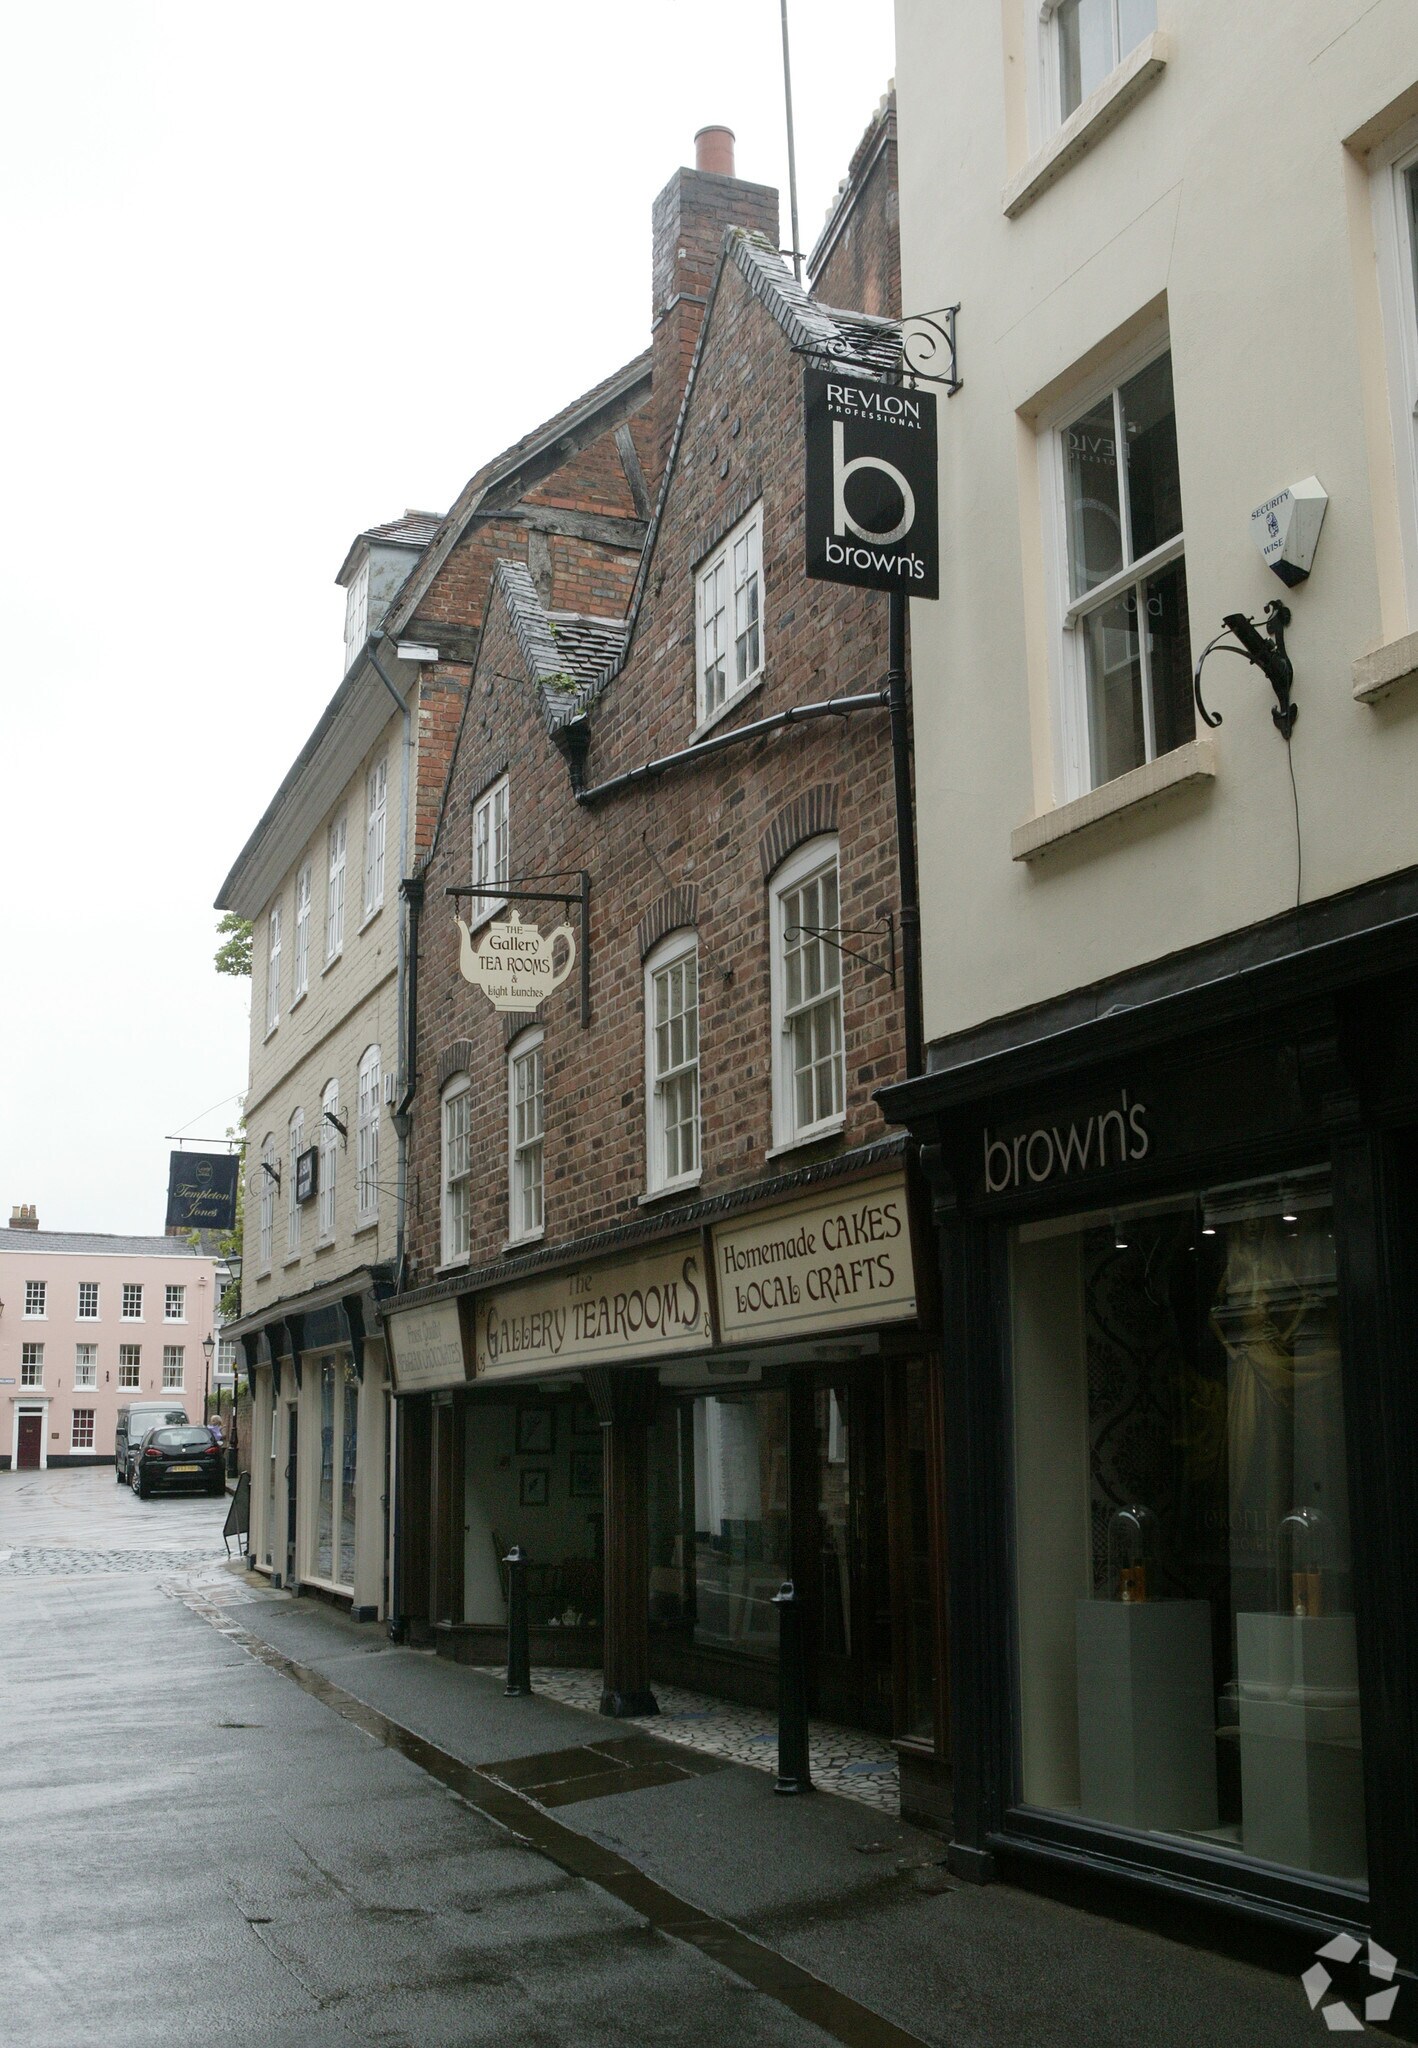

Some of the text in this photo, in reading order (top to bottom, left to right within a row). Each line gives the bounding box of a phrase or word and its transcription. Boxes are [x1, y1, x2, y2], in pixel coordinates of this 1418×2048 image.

[826, 383, 920, 420] REVLON
[832, 420, 916, 546] b
[1251, 490, 1290, 521] SECURITY
[825, 537, 925, 580] brown's
[1263, 537, 1284, 555] WISE
[490, 935, 539, 954] Gallery
[505, 926, 523, 935] THE
[479, 956, 551, 976] TEA ROOMS
[511, 974, 518, 983] &
[983, 1088, 1149, 1193] brown's
[173, 1183, 230, 1204] Templeton
[181, 1202, 218, 1219] Jones
[723, 1203, 902, 1274] Homemade CAKES
[567, 1270, 593, 1296] The
[735, 1253, 895, 1314] LOCAL CRAFTS
[486, 1256, 701, 1361] GALLERY TEAROOMS
